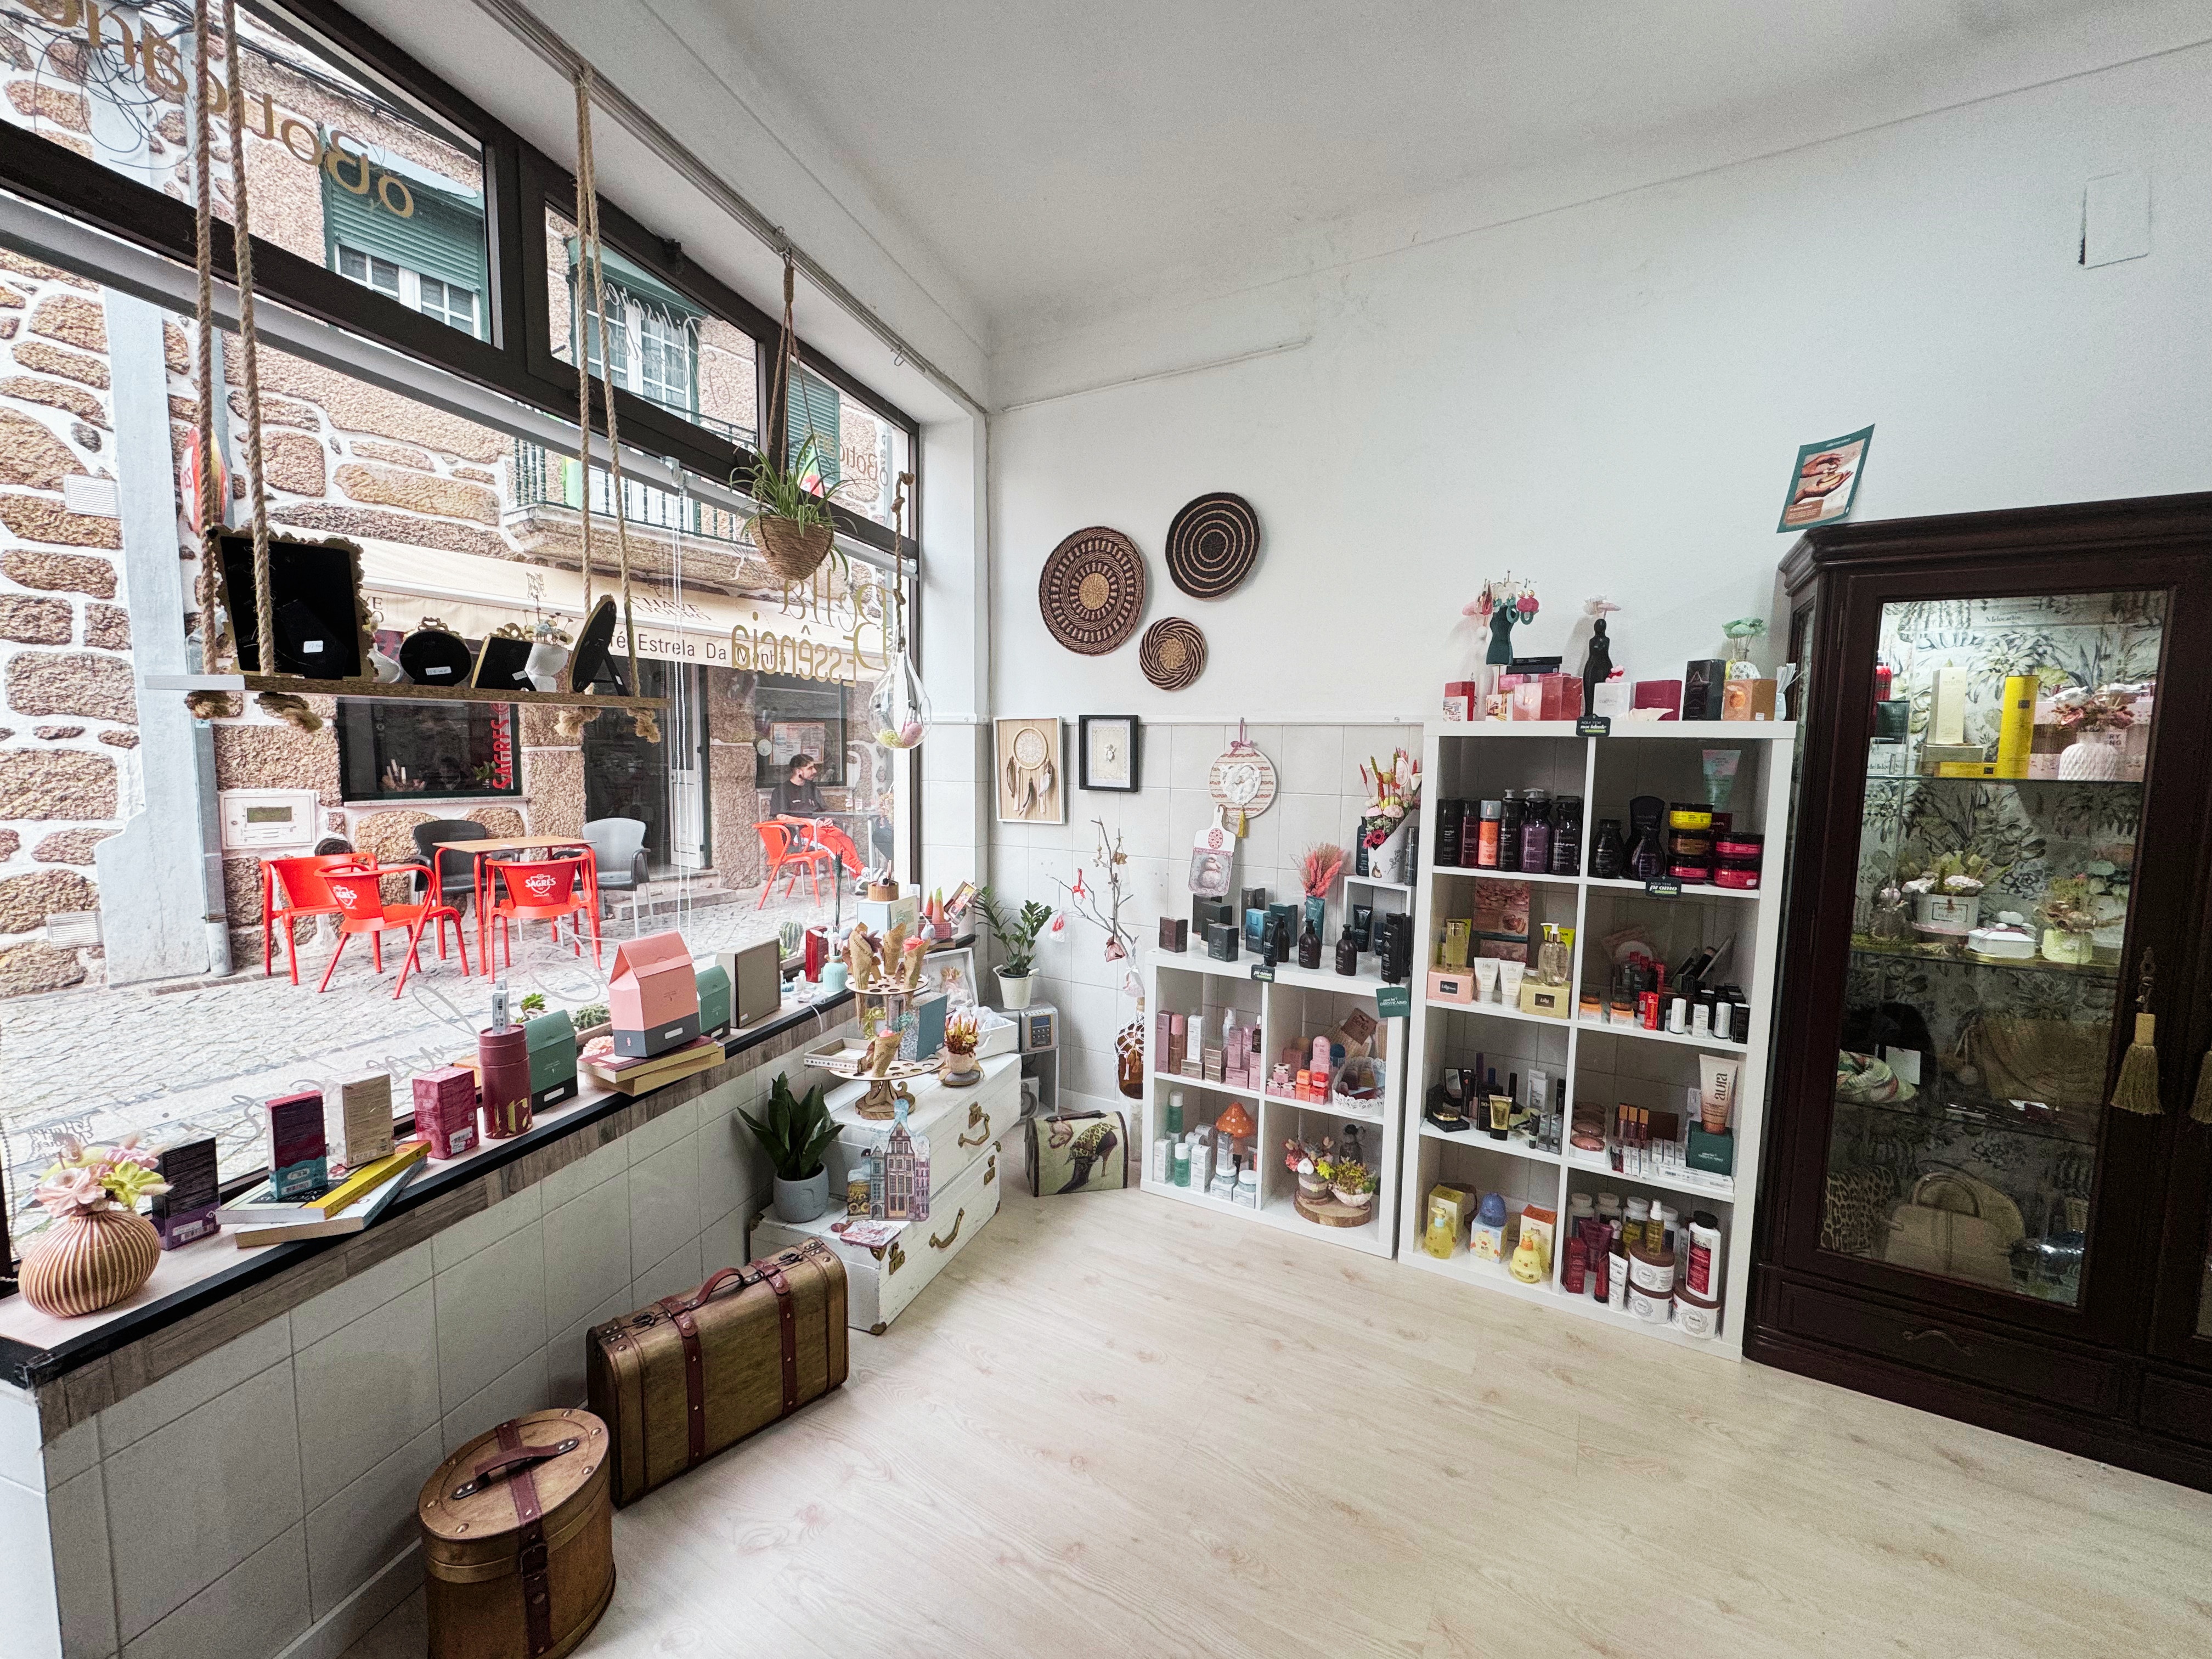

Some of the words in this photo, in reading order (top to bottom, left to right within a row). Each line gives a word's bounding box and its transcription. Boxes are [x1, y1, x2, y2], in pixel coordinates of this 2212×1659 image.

[638, 634, 695, 657] Estrela
[707, 642, 726, 660] Da
[525, 877, 556, 888] SAGRES
[1714, 1072, 1728, 1102] aura
